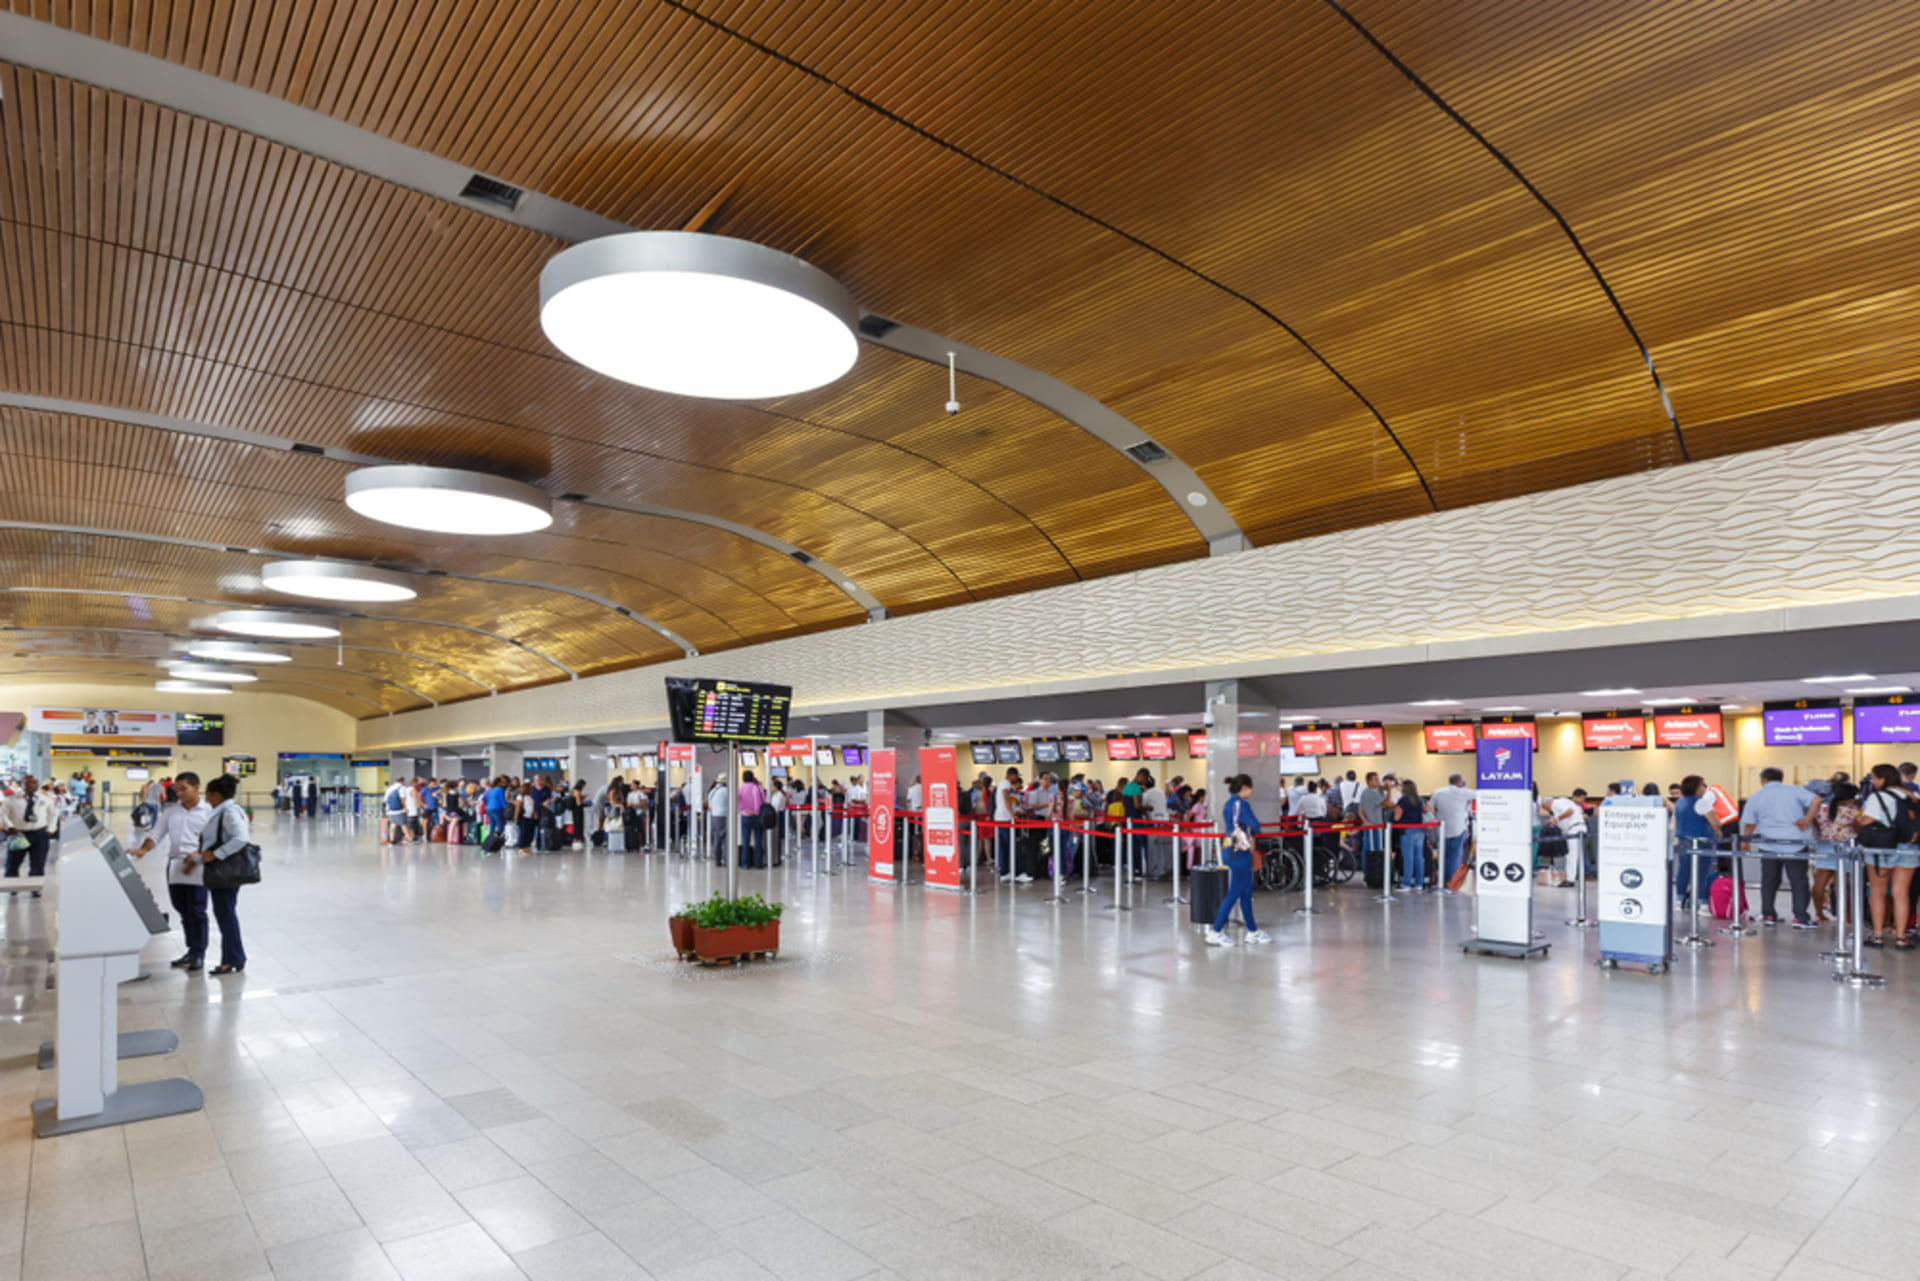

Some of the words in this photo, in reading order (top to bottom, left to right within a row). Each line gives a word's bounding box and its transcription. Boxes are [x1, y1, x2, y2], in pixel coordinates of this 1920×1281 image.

[1794, 700, 1808, 708] 45
[1888, 695, 1903, 704] 46
[1480, 772, 1523, 781] LATAM
[1604, 810, 1641, 821] Entrega
[1643, 812, 1656, 820] de
[1604, 821, 1648, 831] Equipaje
